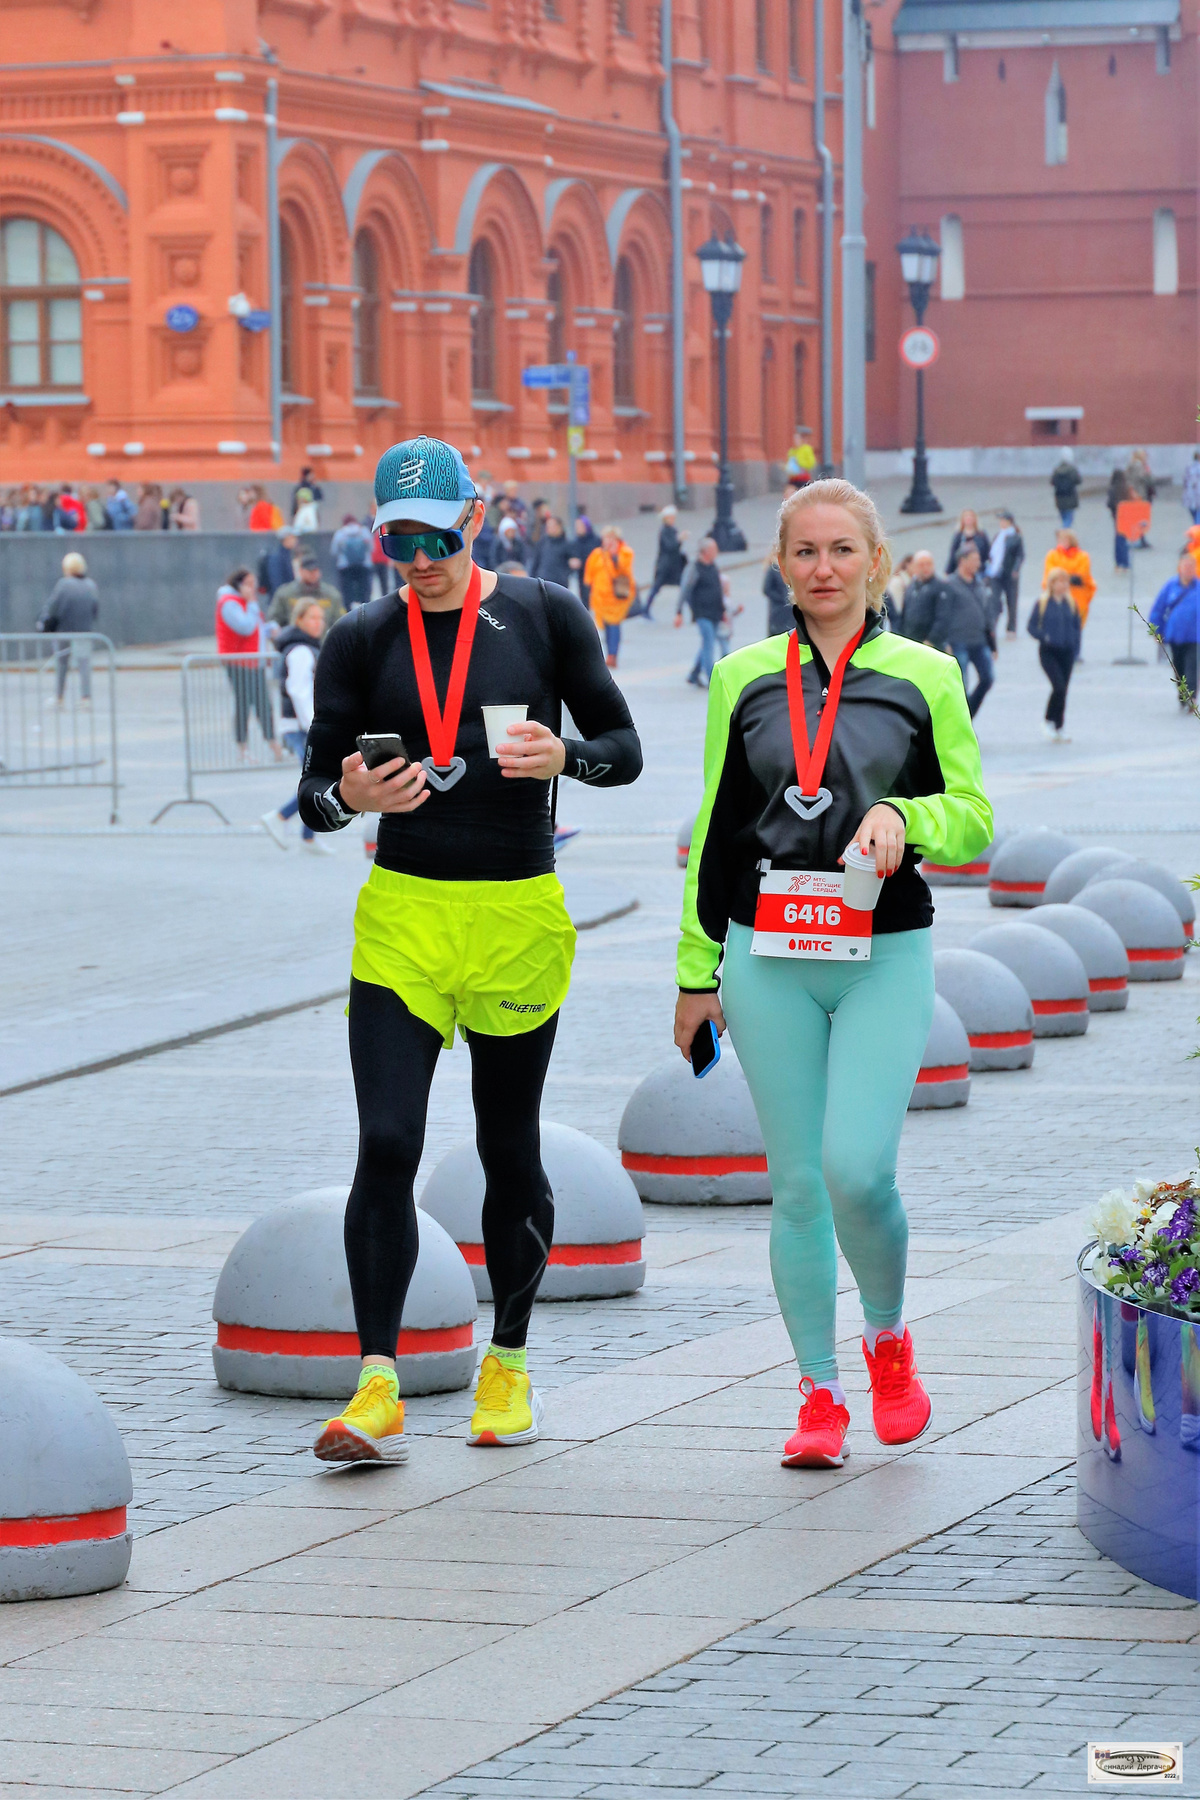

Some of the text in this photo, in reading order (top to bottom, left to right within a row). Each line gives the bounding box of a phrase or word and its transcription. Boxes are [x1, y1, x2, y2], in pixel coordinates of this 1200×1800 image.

[812, 877, 826, 888] МТС
[783, 902, 842, 926] 6416
[797, 938, 833, 952] МТС
